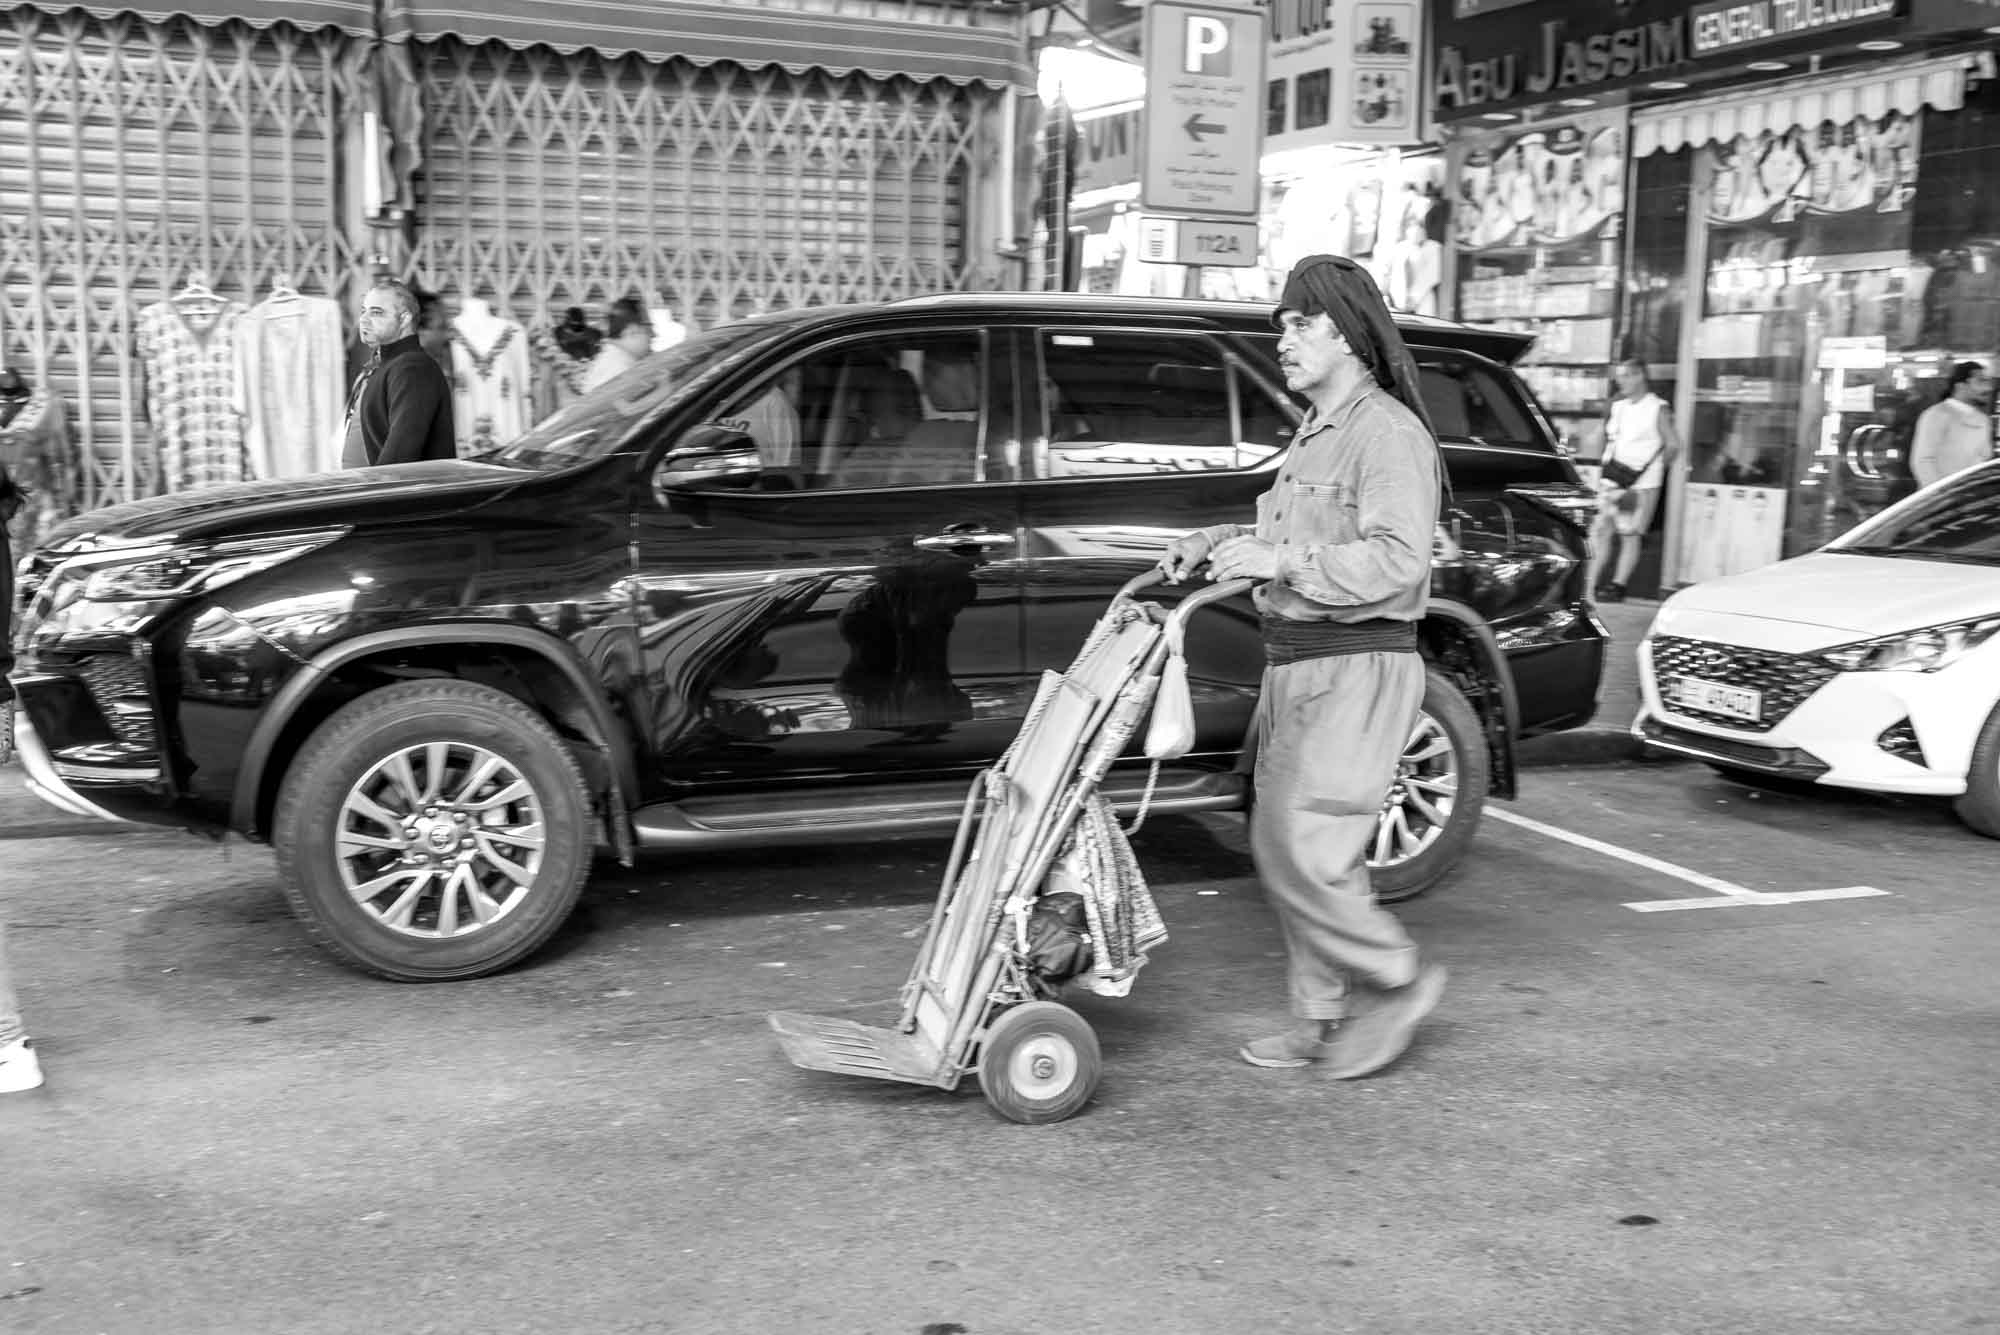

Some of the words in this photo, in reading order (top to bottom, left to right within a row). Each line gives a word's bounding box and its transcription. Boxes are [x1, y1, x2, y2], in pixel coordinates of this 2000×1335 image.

[1185, 15, 1230, 73] P
[1434, 46, 1516, 107] ABU
[1525, 16, 1684, 93] JASSIM
